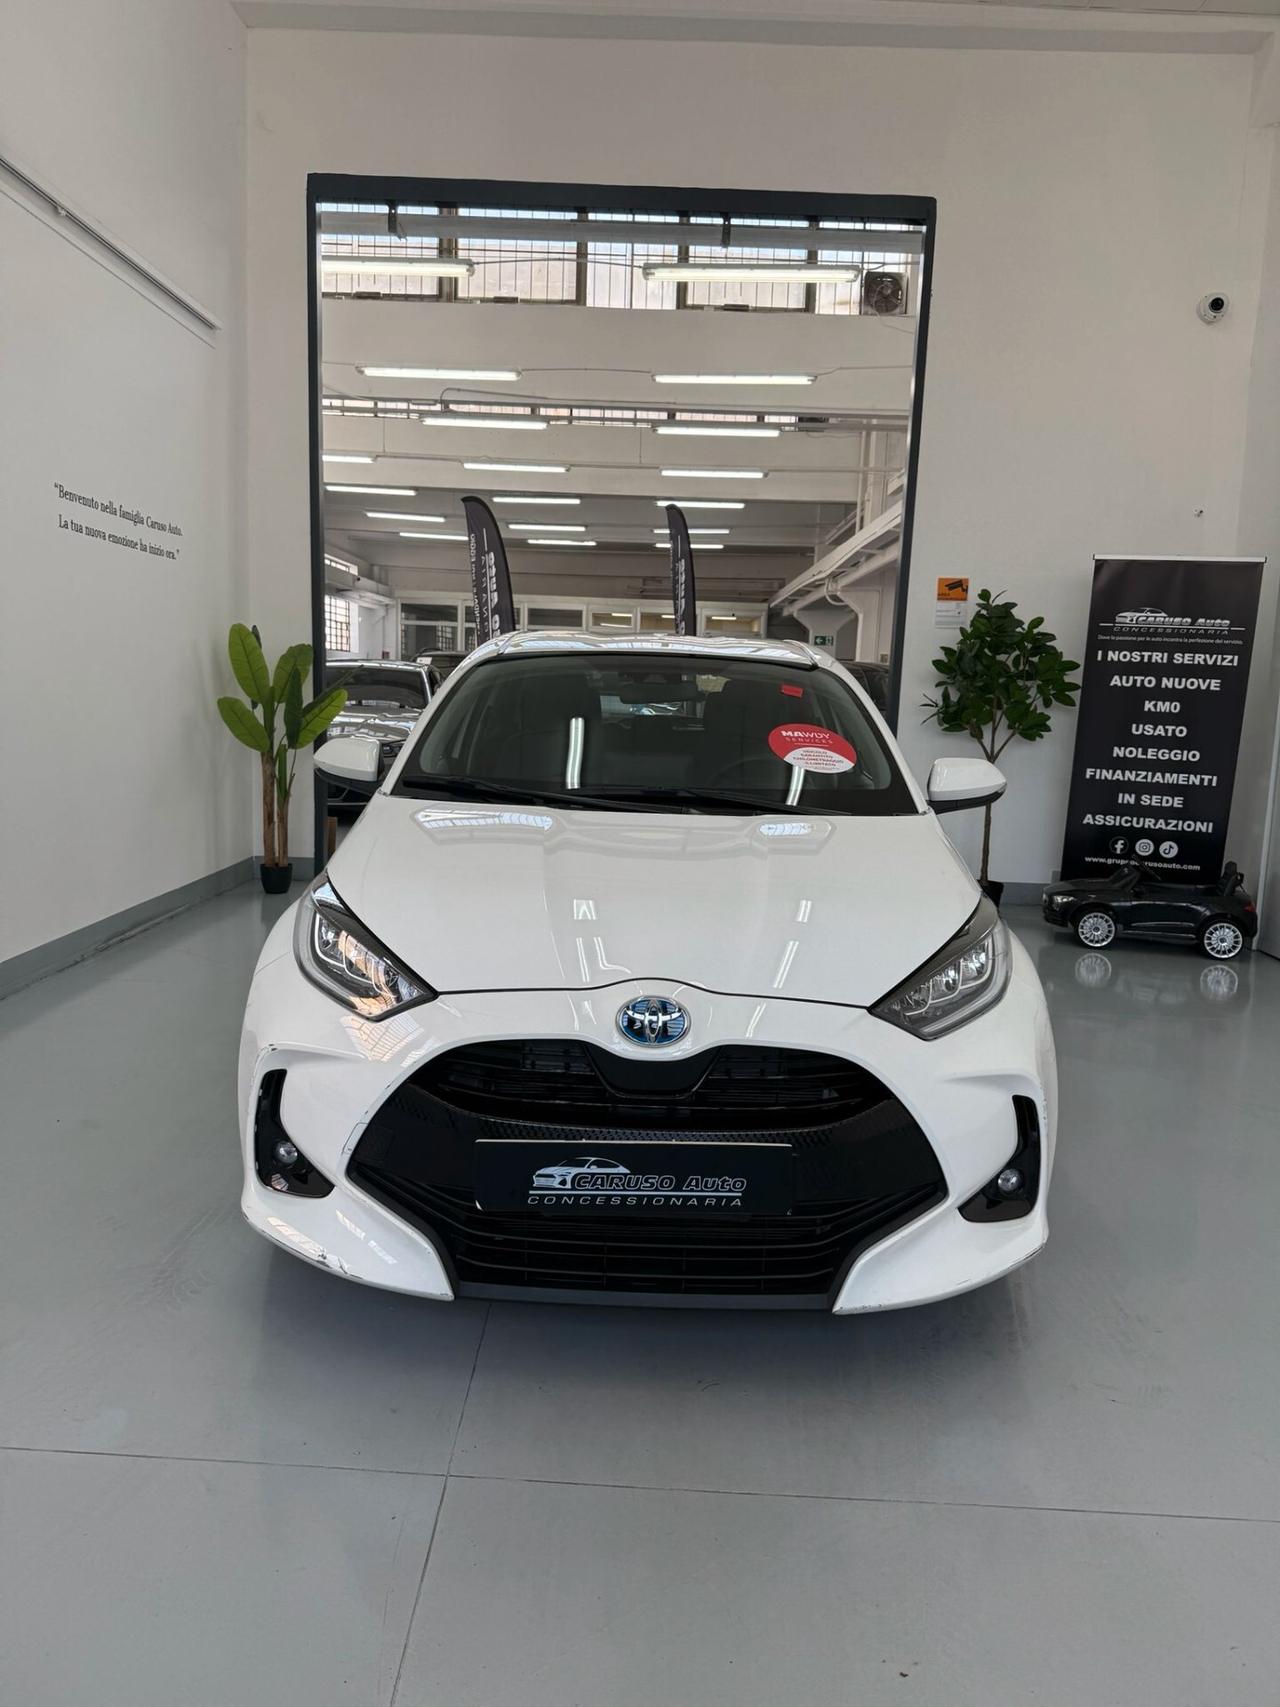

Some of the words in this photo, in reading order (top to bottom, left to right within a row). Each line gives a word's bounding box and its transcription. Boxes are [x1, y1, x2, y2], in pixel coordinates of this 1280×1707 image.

[101, 501, 117, 516] nella
[119, 505, 144, 526] famiglia
[146, 516, 167, 532] Caruso
[168, 522, 182, 536] Auto.
[59, 514, 69, 529] La
[71, 519, 83, 534] tua
[85, 526, 106, 541] nuova
[108, 533, 138, 550] emozione
[140, 539, 148, 552] ha
[149, 542, 164, 557] inizio
[1137, 616, 1192, 625] CARUSO
[1097, 650, 1102, 661] I
[1107, 651, 1167, 663] NOSTRI
[1173, 653, 1238, 666] SERVIZI
[1110, 675, 1156, 687] AUTO
[1161, 677, 1221, 690] NUOVE
[1131, 724, 1187, 737] USATO
[1113, 747, 1200, 761] NOLEGGIO
[1085, 768, 1217, 786] FINANZIAMENTI
[1117, 793, 1135, 804] IN
[1140, 795, 1184, 808] SEDE
[1082, 814, 1213, 833] ASSICURAZIONI
[575, 1173, 676, 1190] CARUSO
[683, 1175, 747, 1191] Auto
[527, 1195, 742, 1206] CONCESSIONARIA
